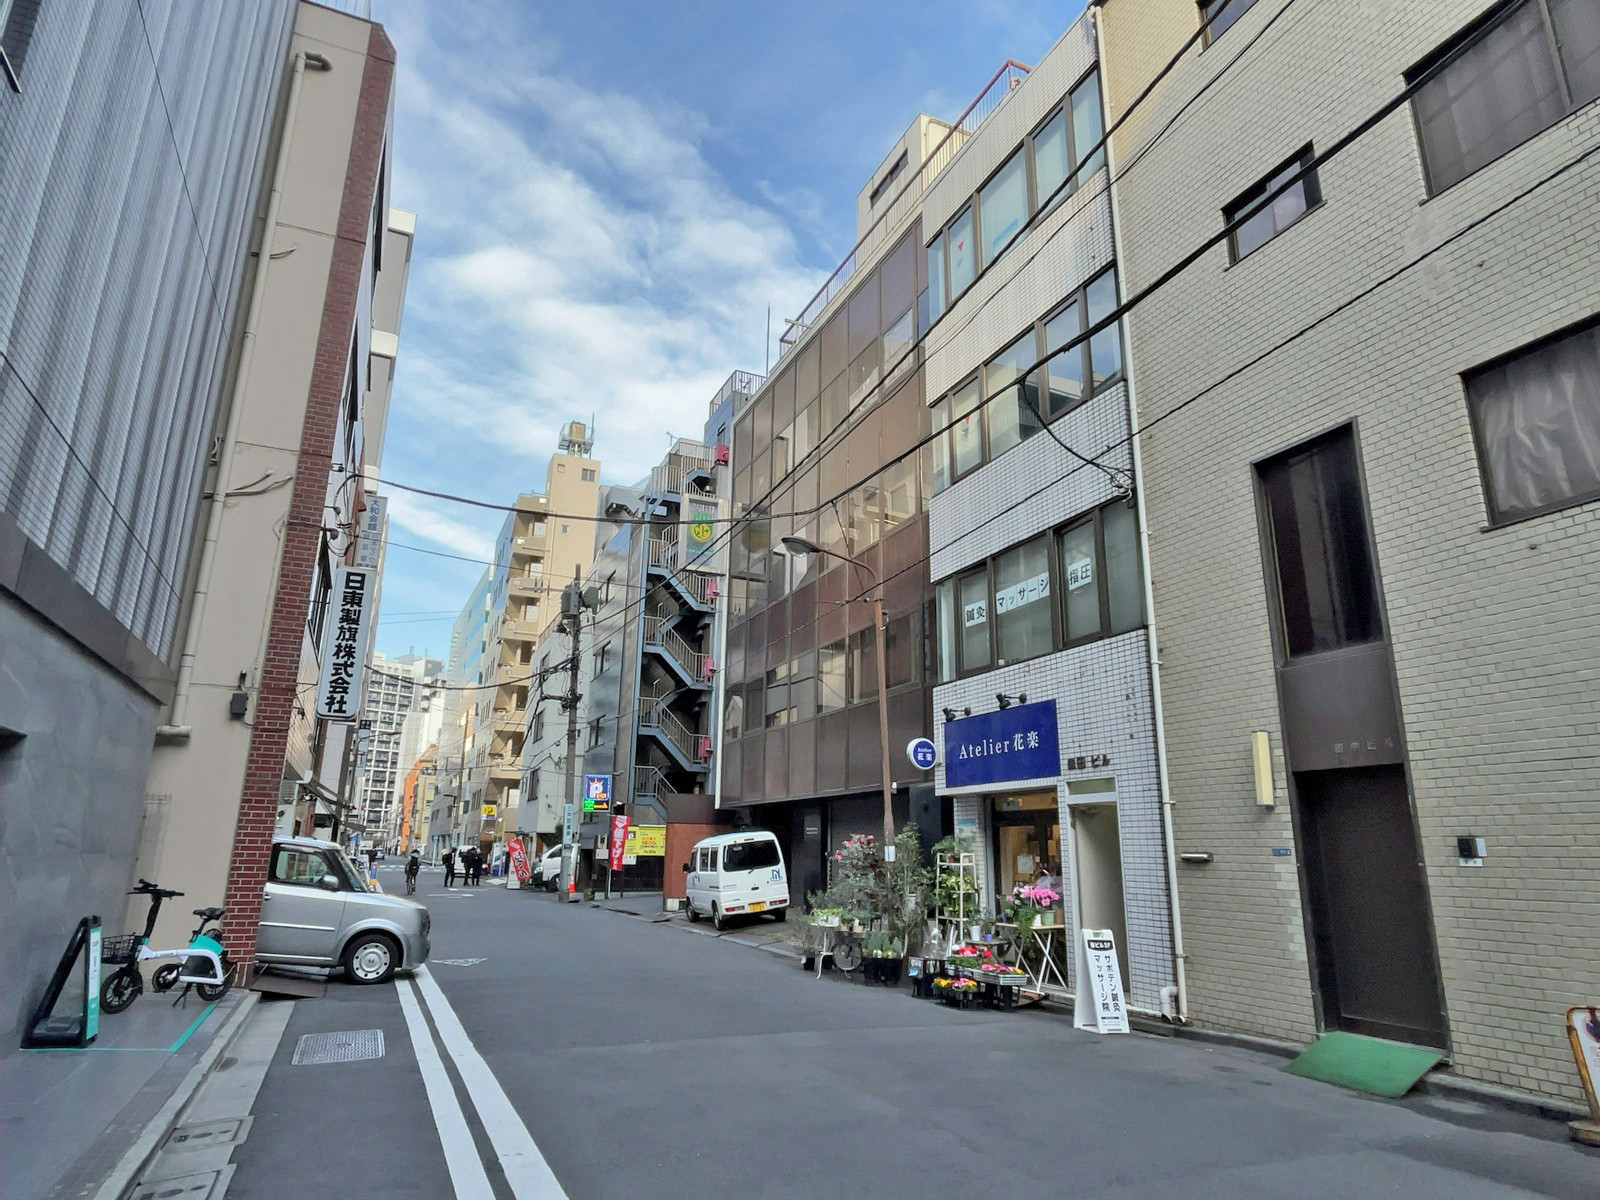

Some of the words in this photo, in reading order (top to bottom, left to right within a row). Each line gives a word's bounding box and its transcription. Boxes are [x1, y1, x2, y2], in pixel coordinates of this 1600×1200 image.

[997, 578, 1050, 607] マッサージ
[1069, 563, 1091, 586] 指圧
[324, 571, 367, 714] 日東製旗株式会社
[959, 738, 1009, 759] Atelier
[1013, 730, 1039, 751] 花楽
[1093, 954, 1111, 1012] マッサージ院
